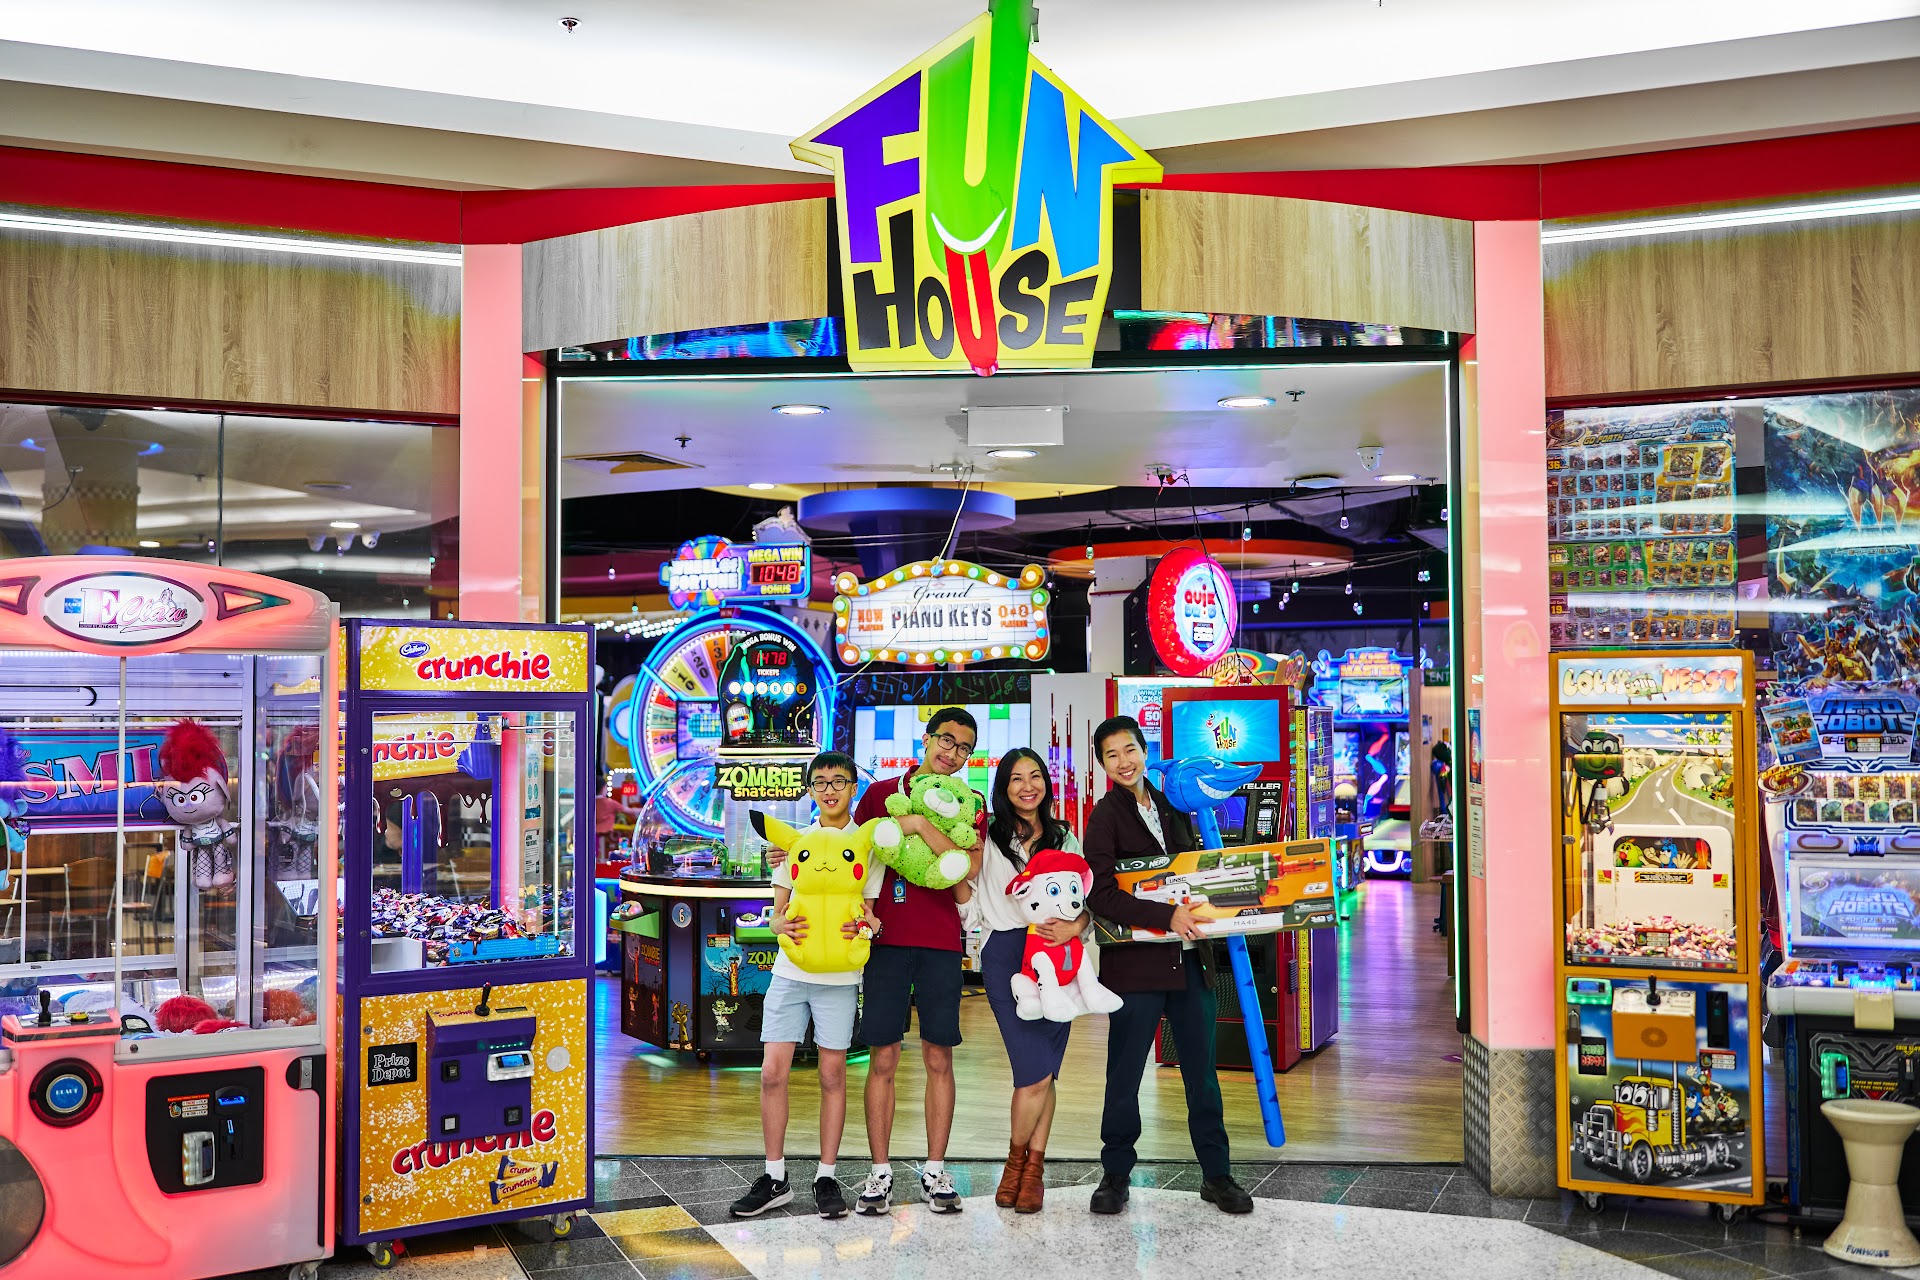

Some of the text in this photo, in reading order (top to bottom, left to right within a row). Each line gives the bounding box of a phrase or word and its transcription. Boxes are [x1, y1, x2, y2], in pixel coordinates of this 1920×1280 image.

[811, 0, 1134, 278] FUN
[852, 209, 1098, 376] HOUSE
[1547, 460, 1561, 470] 36
[748, 547, 803, 563] MEGA WIN
[1550, 553, 1563, 563] 19
[759, 564, 798, 582] 1048
[761, 584, 791, 595] BONUS
[913, 583, 975, 600] Grand
[857, 609, 883, 623] NOW
[891, 602, 991, 629] PIANO KEYS
[1550, 605, 1563, 614] 19
[740, 633, 797, 652] MEGA BONUS WIN
[1349, 652, 1388, 664] LANE
[416, 651, 550, 681] crunchie
[757, 668, 780, 676] TICKETS
[1340, 664, 1402, 676] MASTER
[1563, 668, 1632, 697] LOLLY
[730, 707, 746, 716] LIGHT
[927, 708, 932, 716] 4
[1824, 699, 1905, 714] HERO
[1145, 710, 1160, 721] 50
[1212, 716, 1237, 740] FUN
[1813, 714, 1916, 732] ROBOTS
[717, 766, 803, 787] ZOMBIE
[734, 785, 802, 797] snatcher
[1148, 856, 1170, 869] NERF
[1233, 884, 1257, 893] HALO
[1839, 891, 1897, 902] HERO
[679, 908, 685, 923] 6
[1828, 901, 1912, 917] ROBOTS
[438, 1009, 473, 1018] crunchie
[374, 1052, 410, 1069] Prize
[1581, 1056, 1605, 1066] DEPOT
[371, 1066, 411, 1083] Depot
[501, 1175, 538, 1194] crunchie
[1845, 1244, 1889, 1258] FUNHOUSE
